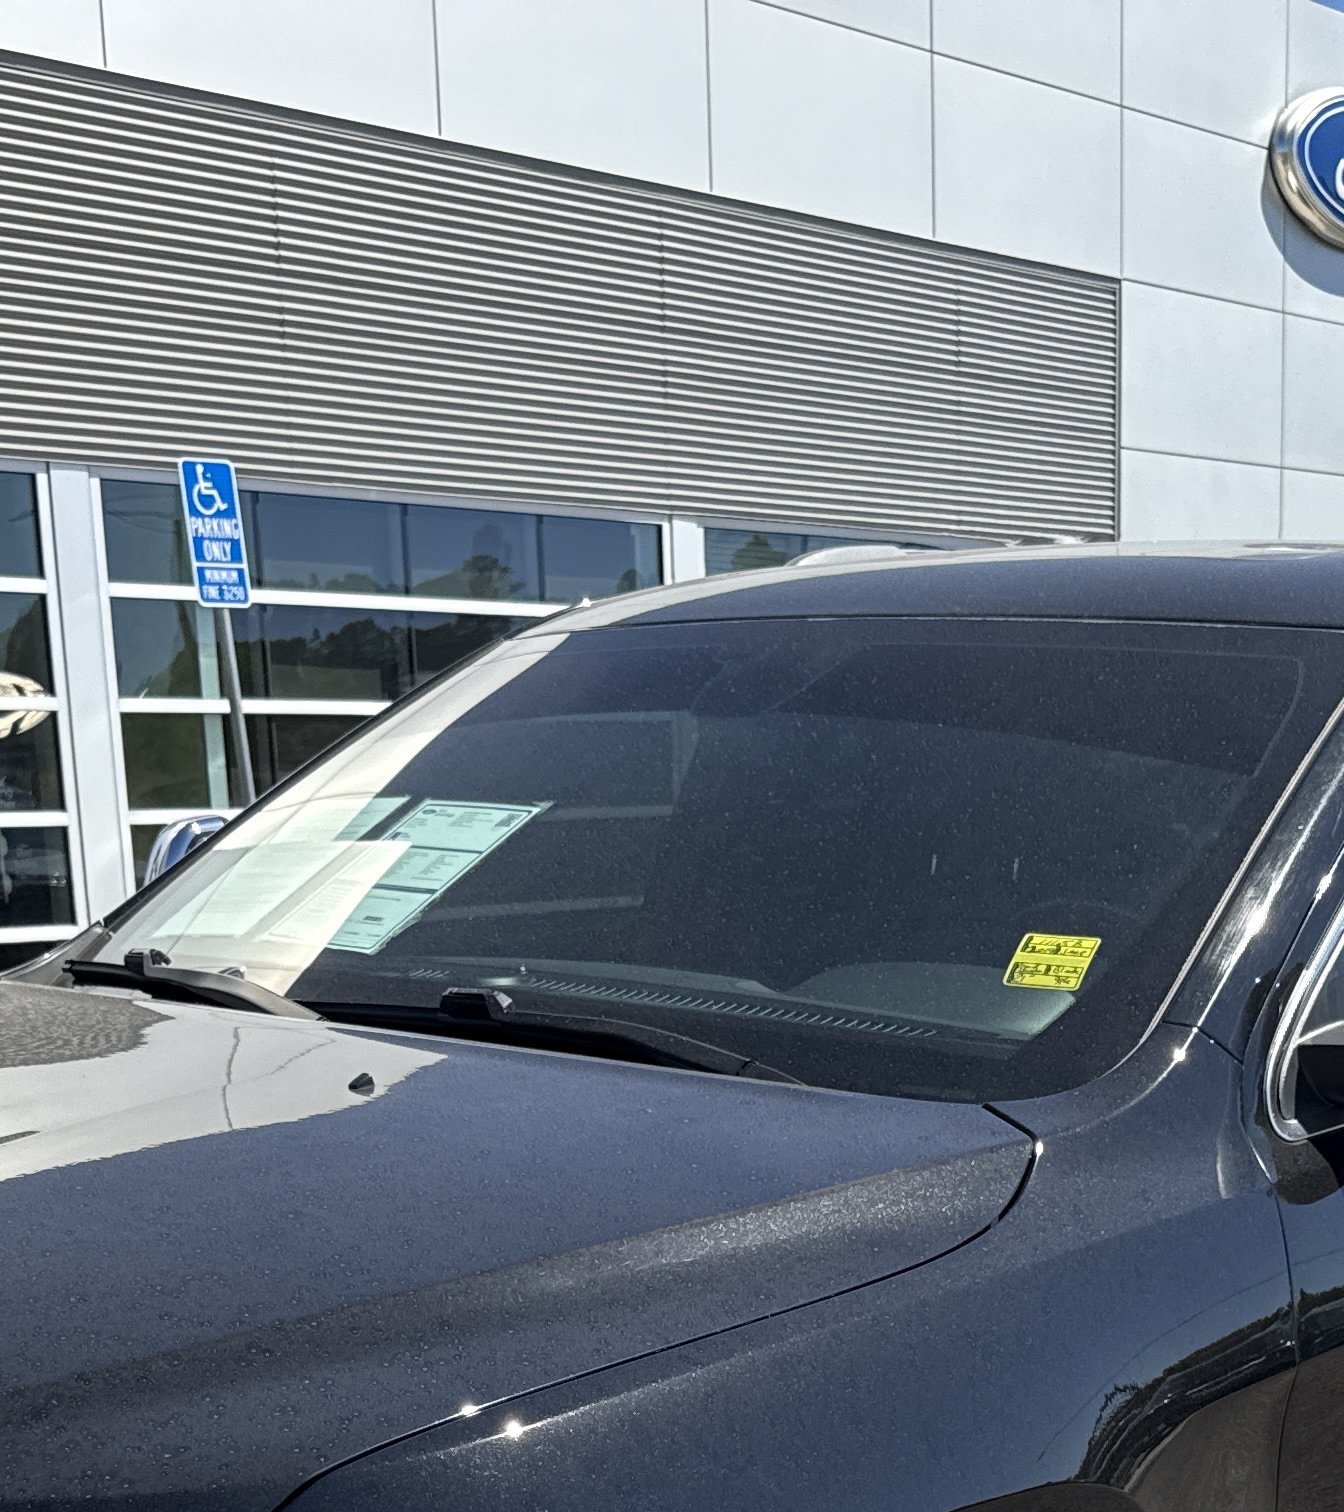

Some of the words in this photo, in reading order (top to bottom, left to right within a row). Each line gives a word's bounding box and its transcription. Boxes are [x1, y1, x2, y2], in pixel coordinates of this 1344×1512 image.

[190, 516, 240, 540] PARKING
[202, 540, 232, 562] ONLY
[204, 569, 239, 584] MINIMUM
[202, 584, 220, 600] FINE
